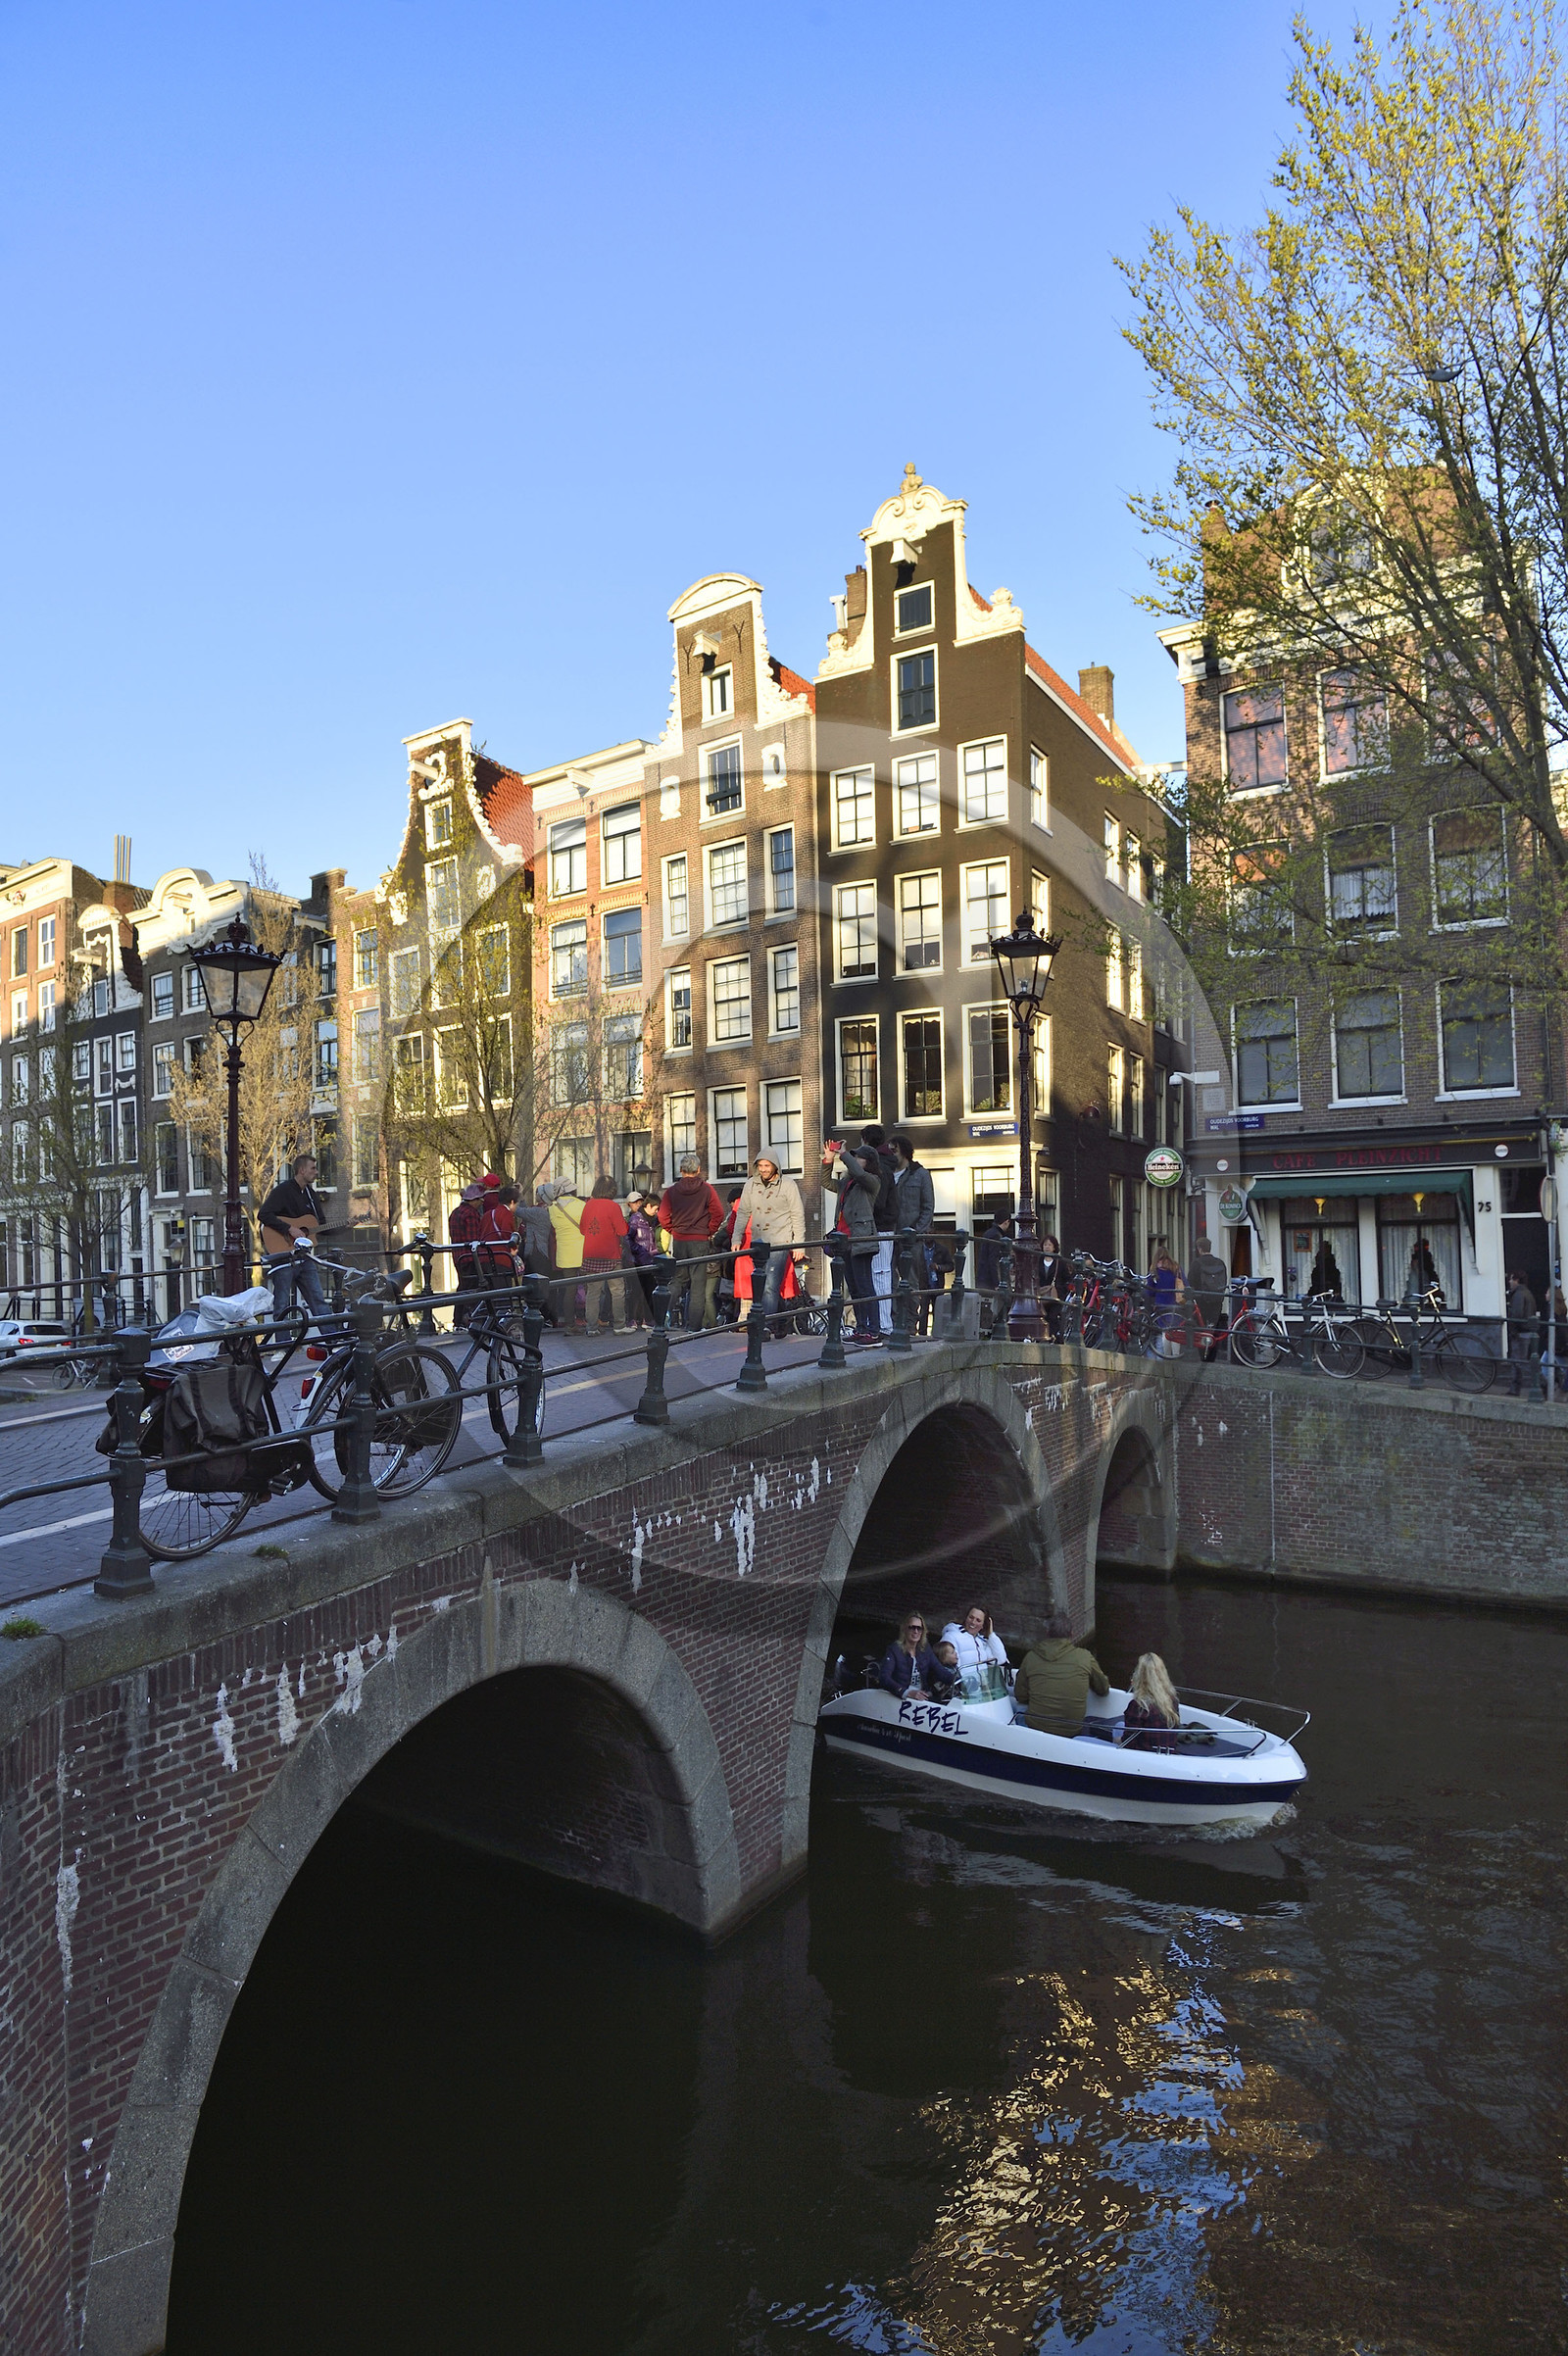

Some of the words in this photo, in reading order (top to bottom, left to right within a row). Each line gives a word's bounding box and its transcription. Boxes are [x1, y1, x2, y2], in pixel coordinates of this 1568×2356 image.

[1336, 1147, 1444, 1166] PLEINZICHT
[1147, 1162, 1179, 1171] Heineken
[1477, 1201, 1492, 1212] 75
[899, 1700, 969, 1736] REBEL
